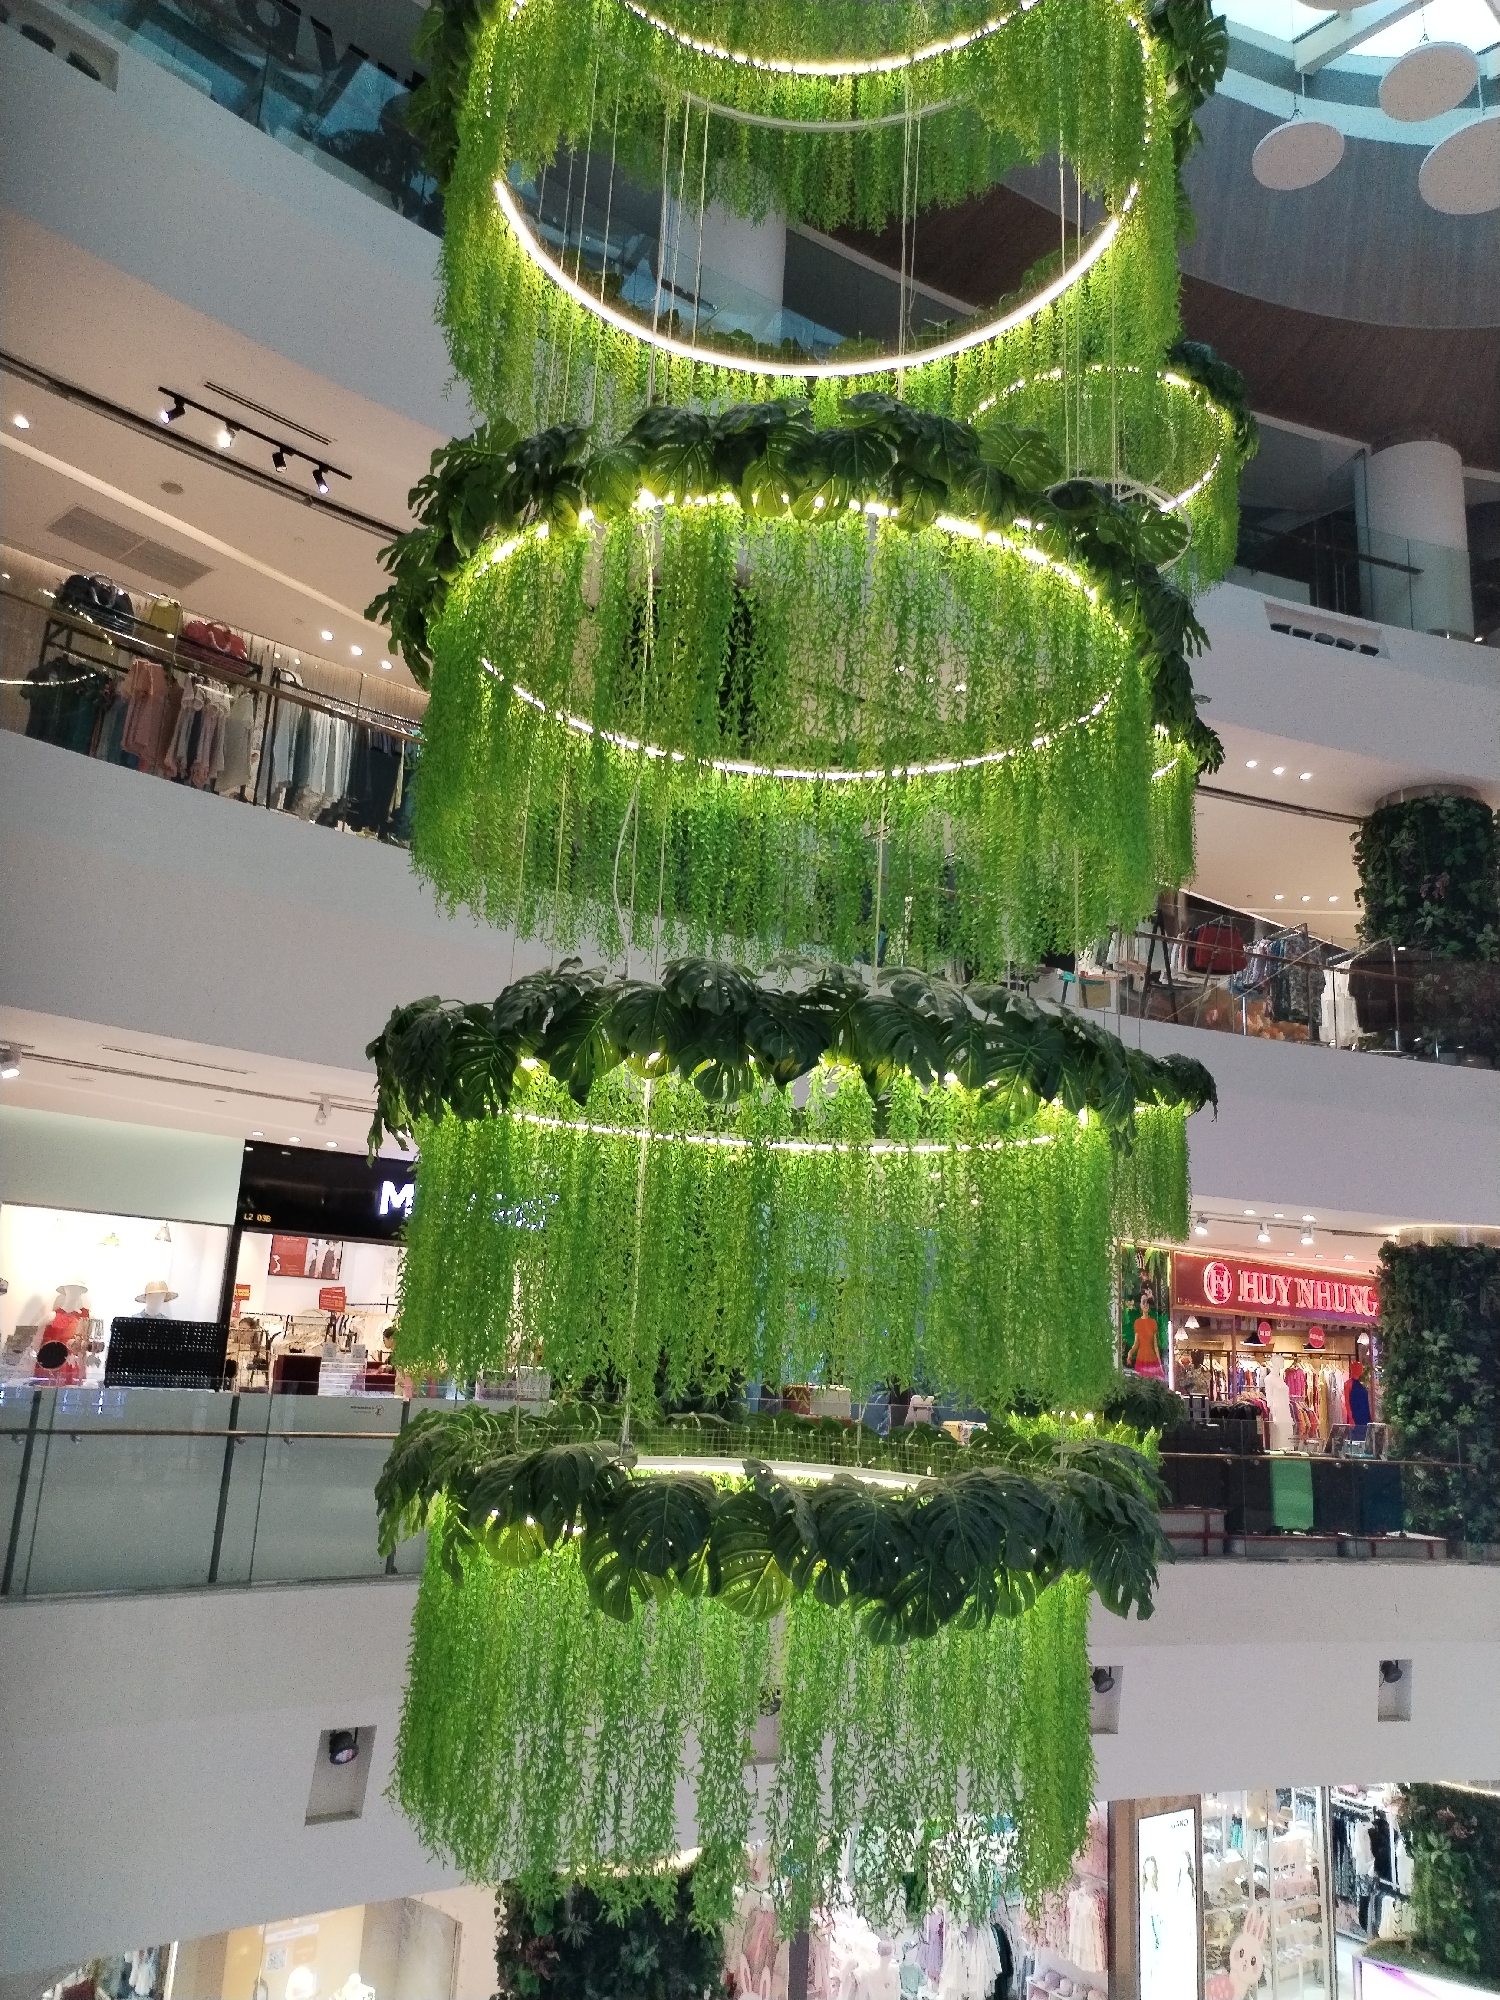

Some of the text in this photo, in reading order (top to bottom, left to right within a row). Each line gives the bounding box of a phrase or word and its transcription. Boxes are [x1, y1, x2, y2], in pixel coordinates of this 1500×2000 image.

[243, 1212, 254, 1221] L2
[379, 1180, 416, 1217] M
[1237, 1269, 1380, 1317] HUY NHUNG
